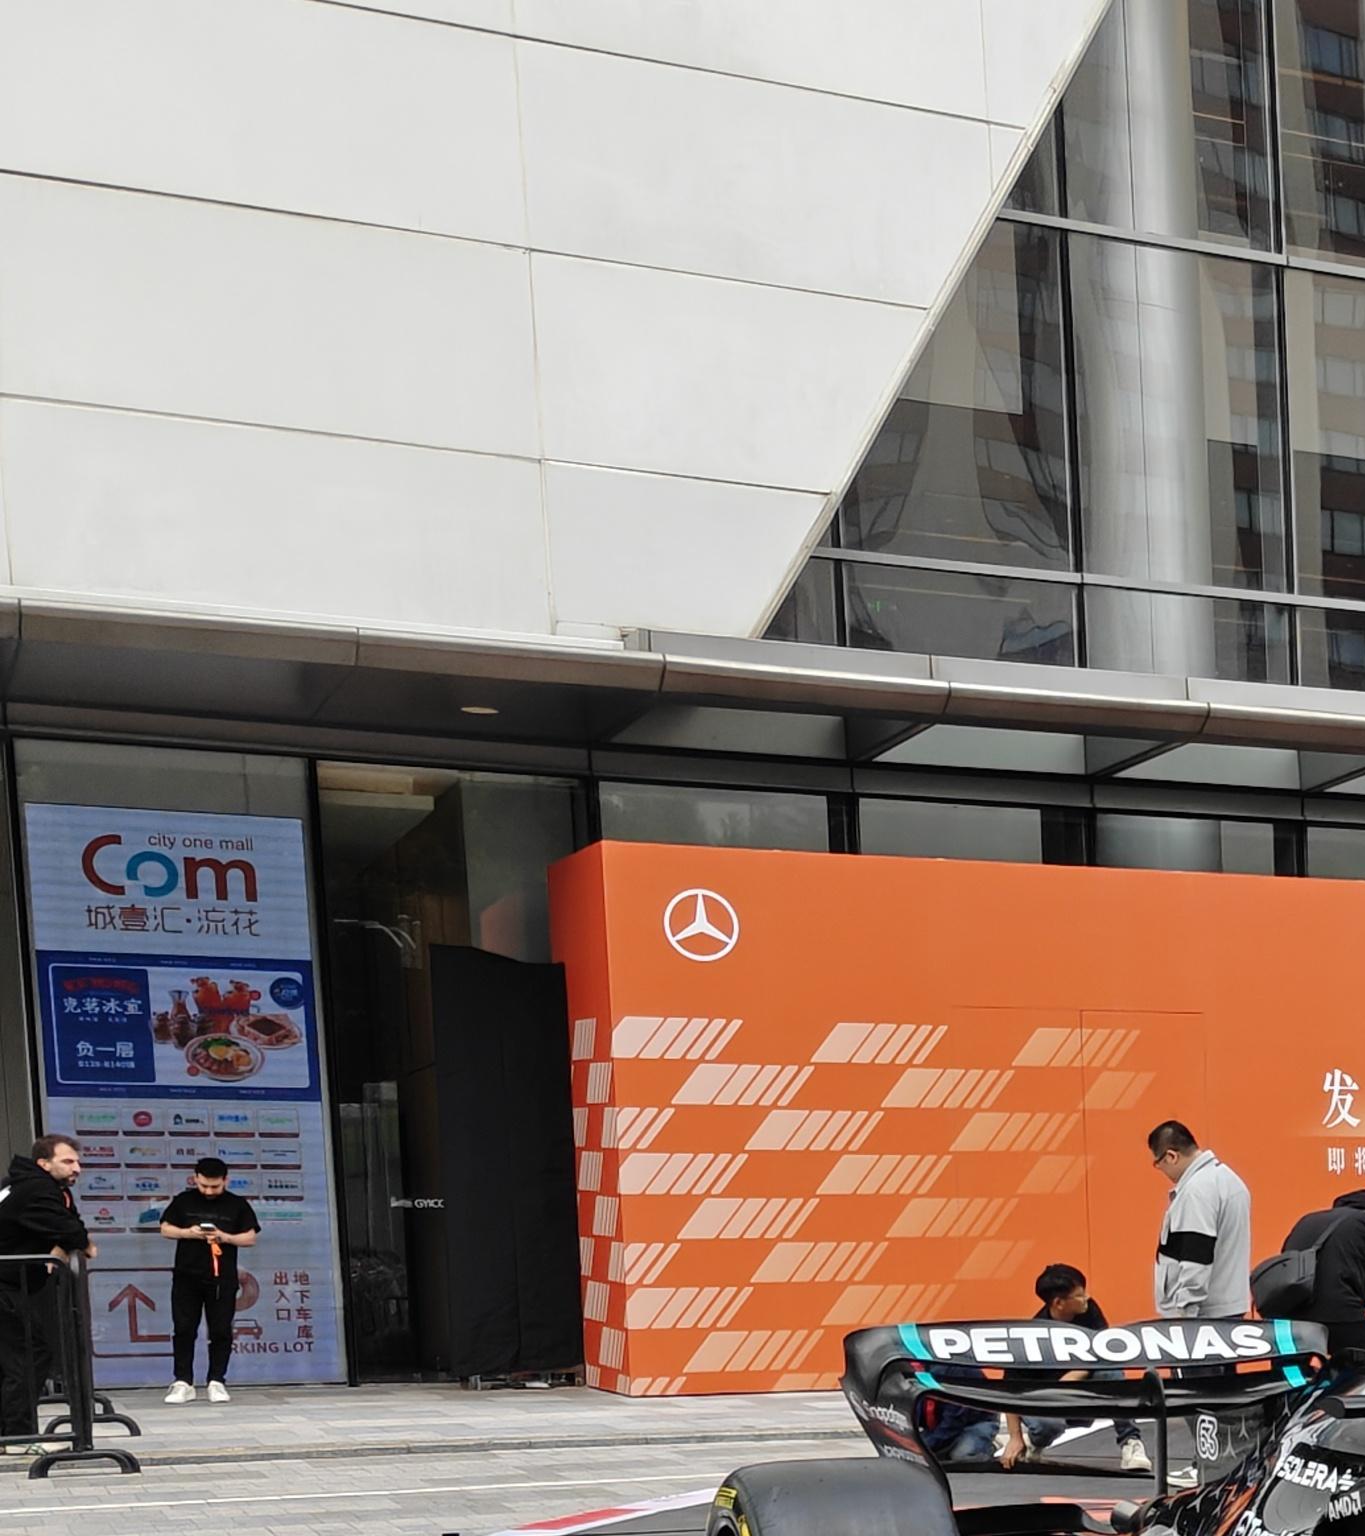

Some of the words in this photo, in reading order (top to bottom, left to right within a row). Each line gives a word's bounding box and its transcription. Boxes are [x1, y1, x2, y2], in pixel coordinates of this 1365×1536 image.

[148, 833, 175, 849] city
[182, 837, 213, 849] one
[219, 837, 254, 851] mall
[85, 904, 260, 937] 城壹汇·流花
[76, 1041, 135, 1058] 负一层
[273, 1271, 291, 1321] 出入口
[293, 1271, 314, 1339] 地下车库
[231, 1342, 280, 1354] RKING
[283, 1341, 314, 1353] LOT
[928, 1325, 1272, 1363] PETRONAS
[1197, 1414, 1220, 1462] 63
[1277, 1455, 1338, 1493] SOLERA
[1328, 1494, 1353, 1522] AMD
